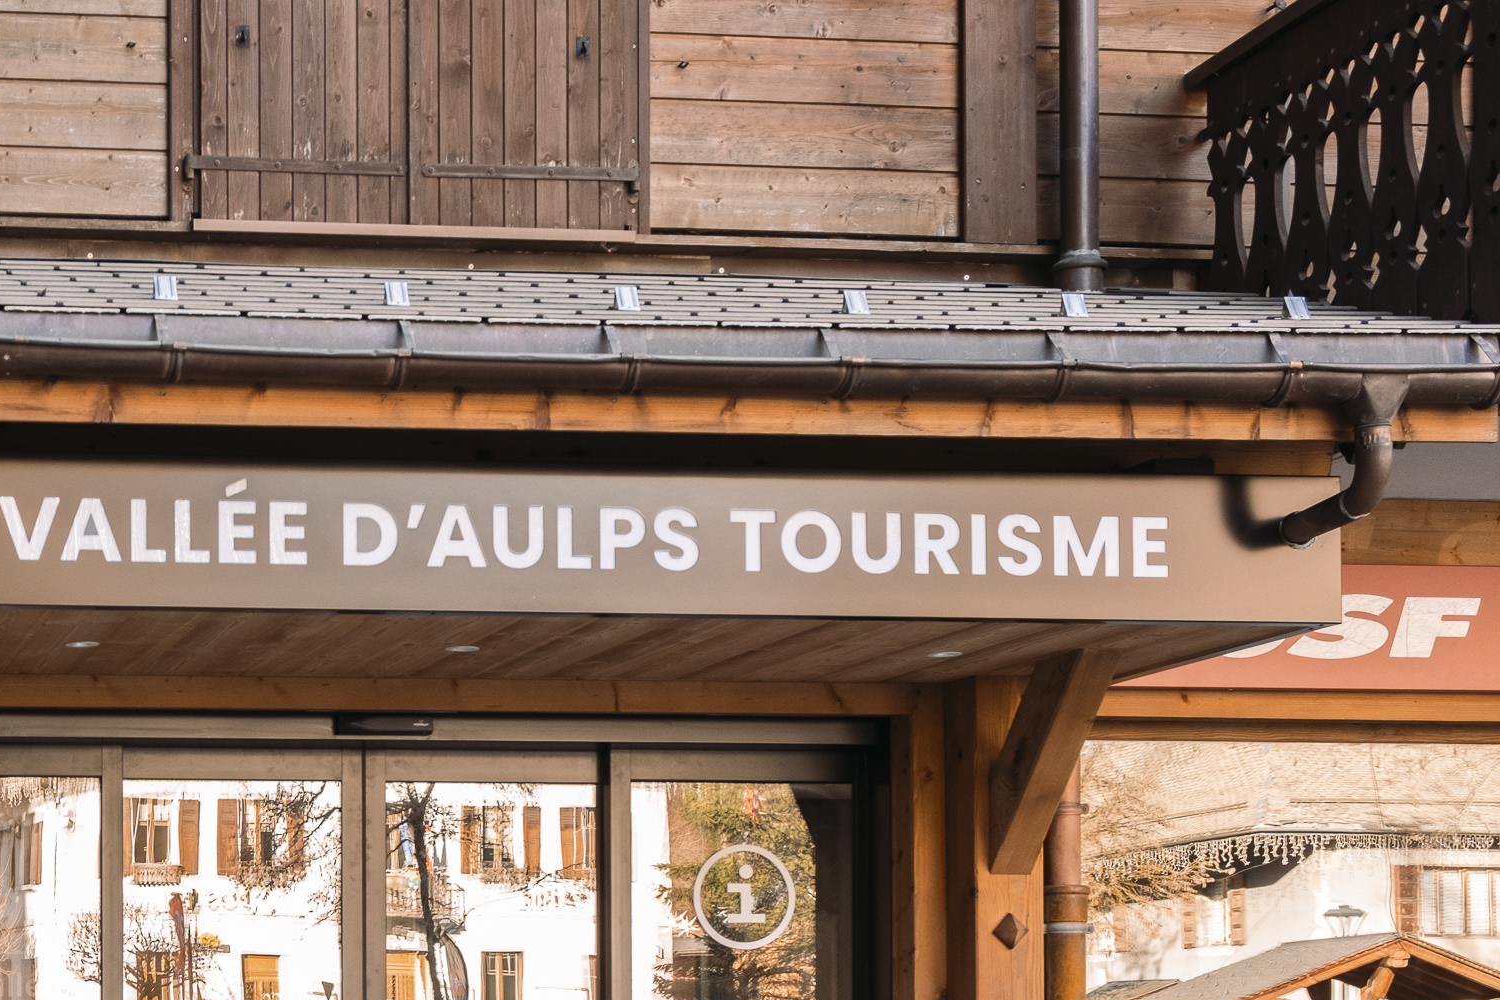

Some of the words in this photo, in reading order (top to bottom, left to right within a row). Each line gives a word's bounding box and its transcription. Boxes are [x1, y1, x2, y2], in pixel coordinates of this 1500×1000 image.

[342, 502, 700, 572] D'AULPS
[730, 507, 1169, 578] TOURISME
[1223, 594, 1481, 660] SF
